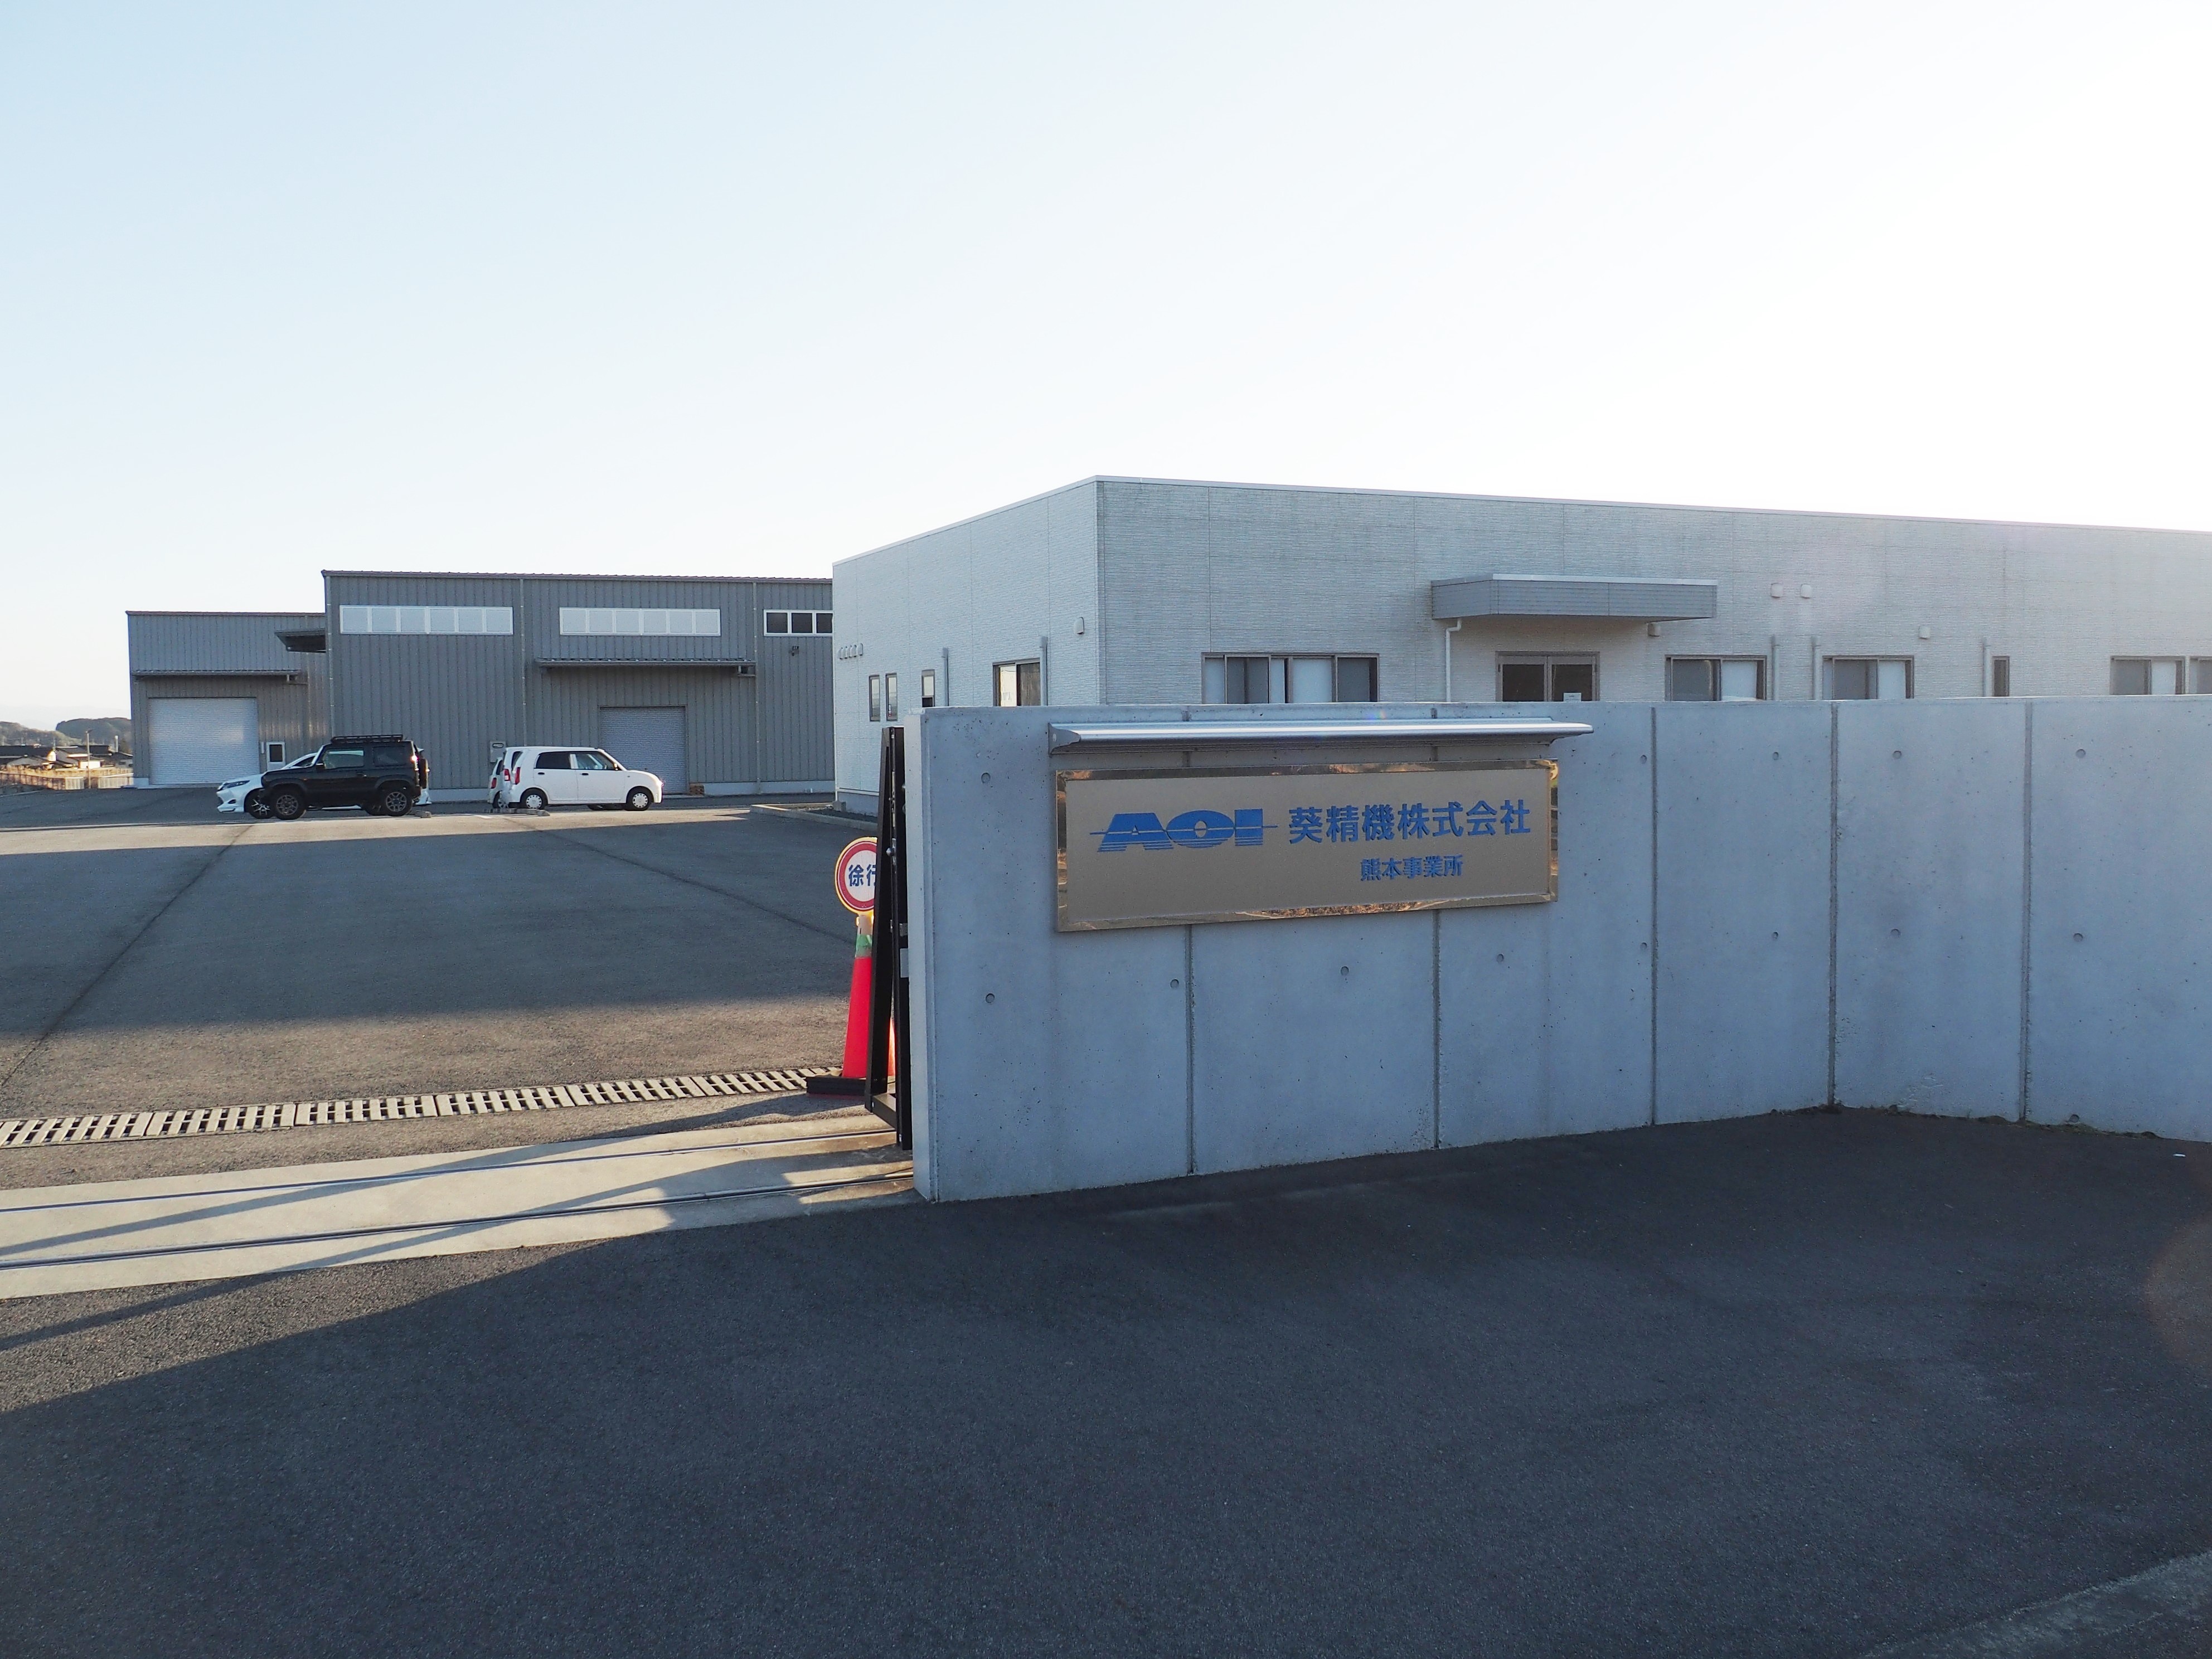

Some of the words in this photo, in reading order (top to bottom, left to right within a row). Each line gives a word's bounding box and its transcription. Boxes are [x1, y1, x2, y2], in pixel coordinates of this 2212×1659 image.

[1096, 808, 1264, 853] AOI
[1288, 798, 1531, 844] 葵精機株式会社
[1360, 853, 1464, 881] 熊本事業所
